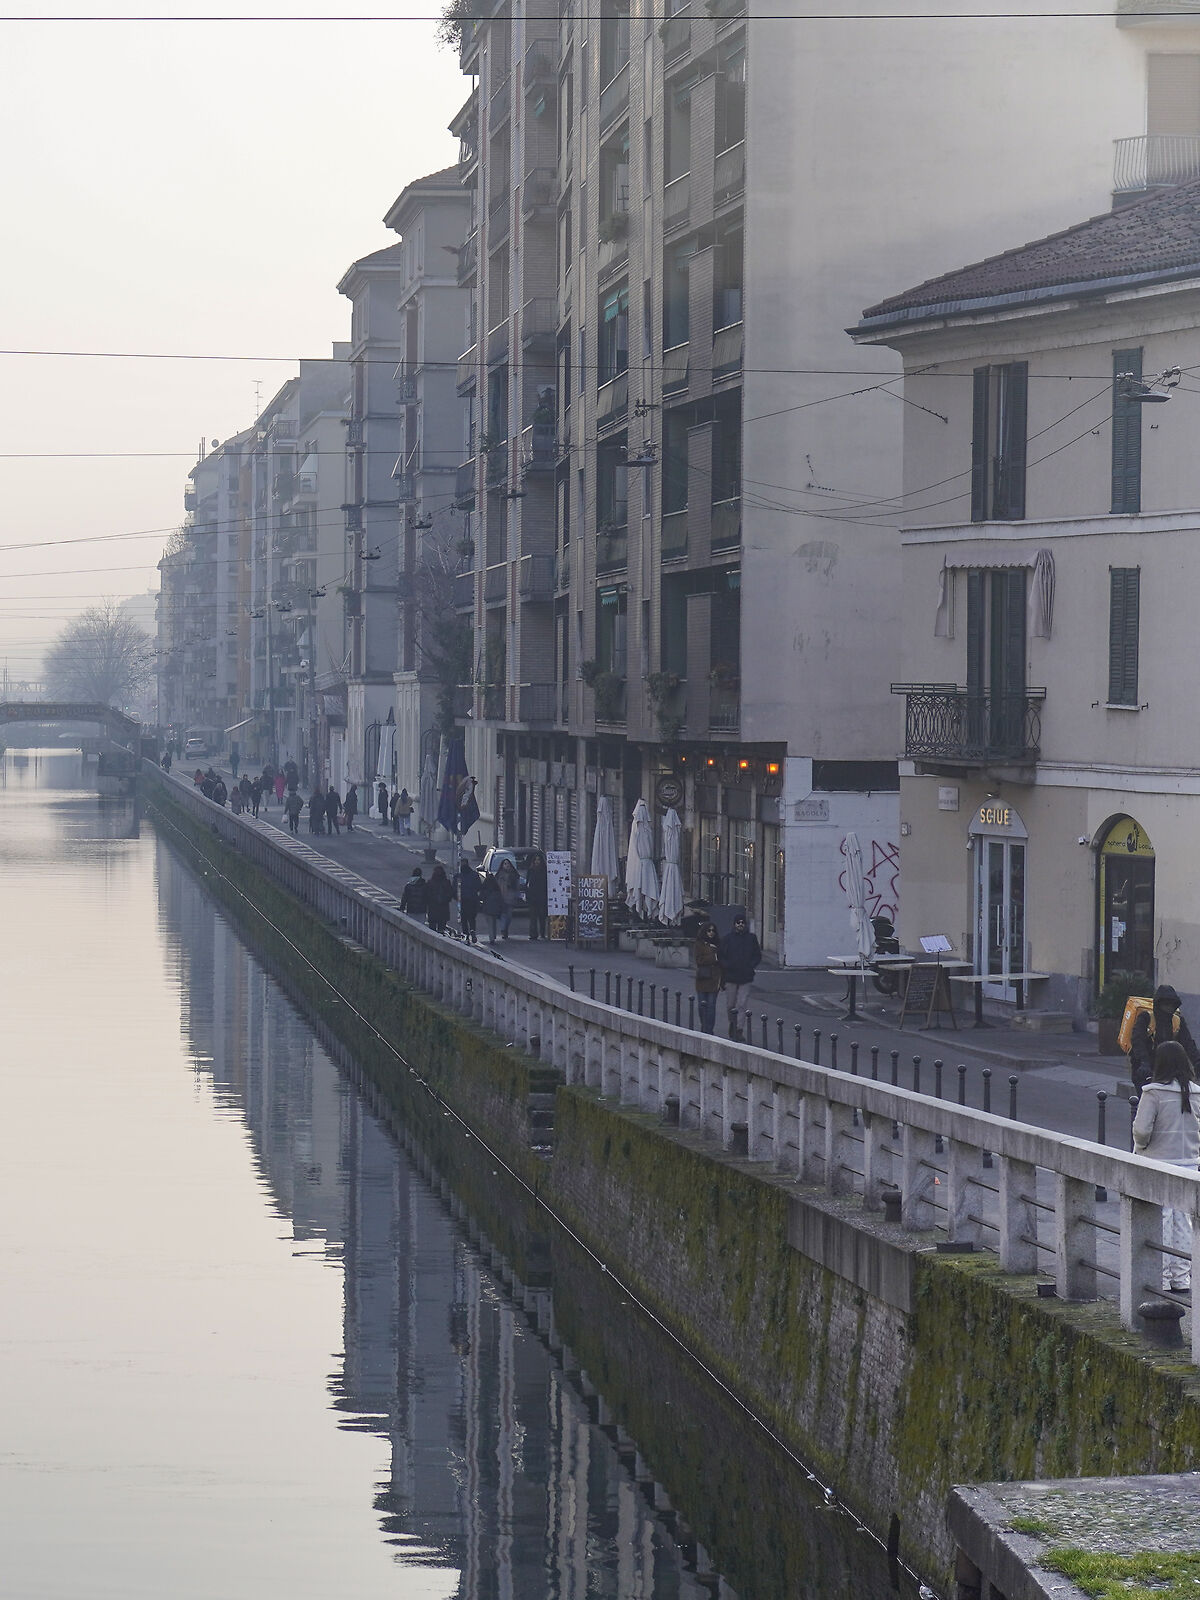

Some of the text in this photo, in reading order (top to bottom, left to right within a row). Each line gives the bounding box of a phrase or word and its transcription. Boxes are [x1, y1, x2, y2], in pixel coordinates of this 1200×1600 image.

[578, 878, 604, 888] HAPPY
[578, 888, 604, 898] HOURS
[578, 899, 604, 911] 18-20
